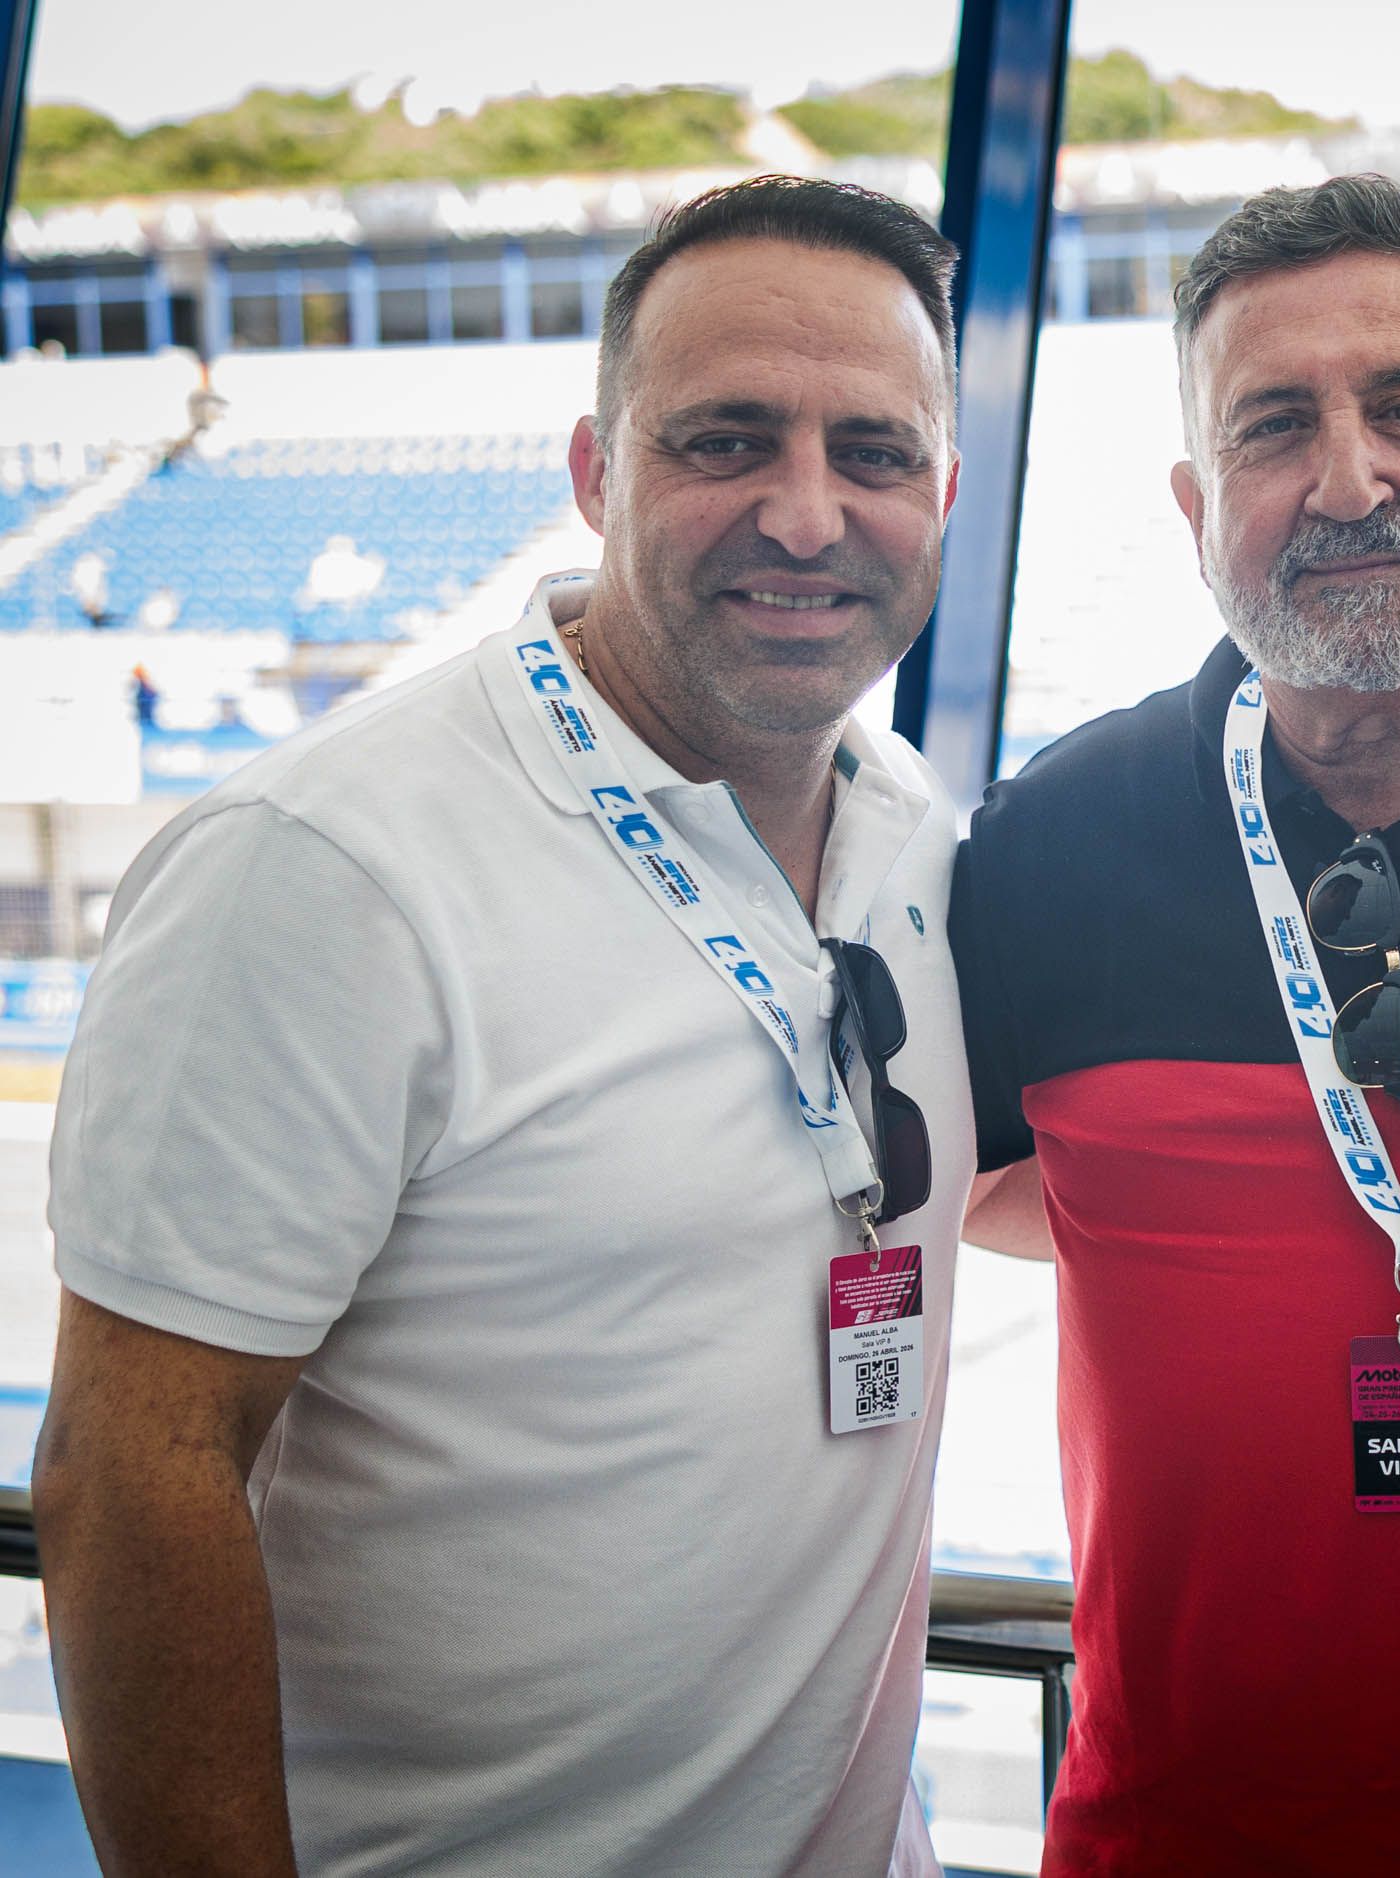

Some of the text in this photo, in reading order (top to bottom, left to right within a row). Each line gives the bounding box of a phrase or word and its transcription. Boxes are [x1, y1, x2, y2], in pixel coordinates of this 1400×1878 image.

[516, 639, 572, 696] 40
[559, 699, 596, 751] JEREZ
[1235, 748, 1247, 799] JEREZ
[590, 785, 664, 851] 40
[1240, 801, 1277, 865] 40
[654, 852, 700, 904] JEREZ
[703, 935, 775, 997] 40
[1273, 916, 1297, 970] JEREZ
[1285, 972, 1332, 1039] 40
[1325, 1088, 1357, 1145] JEREZ
[854, 1326, 899, 1339] MANUEL ALBA
[861, 1340, 874, 1348] Sala
[875, 1338, 886, 1346] VIP
[900, 1344, 914, 1352] 2026
